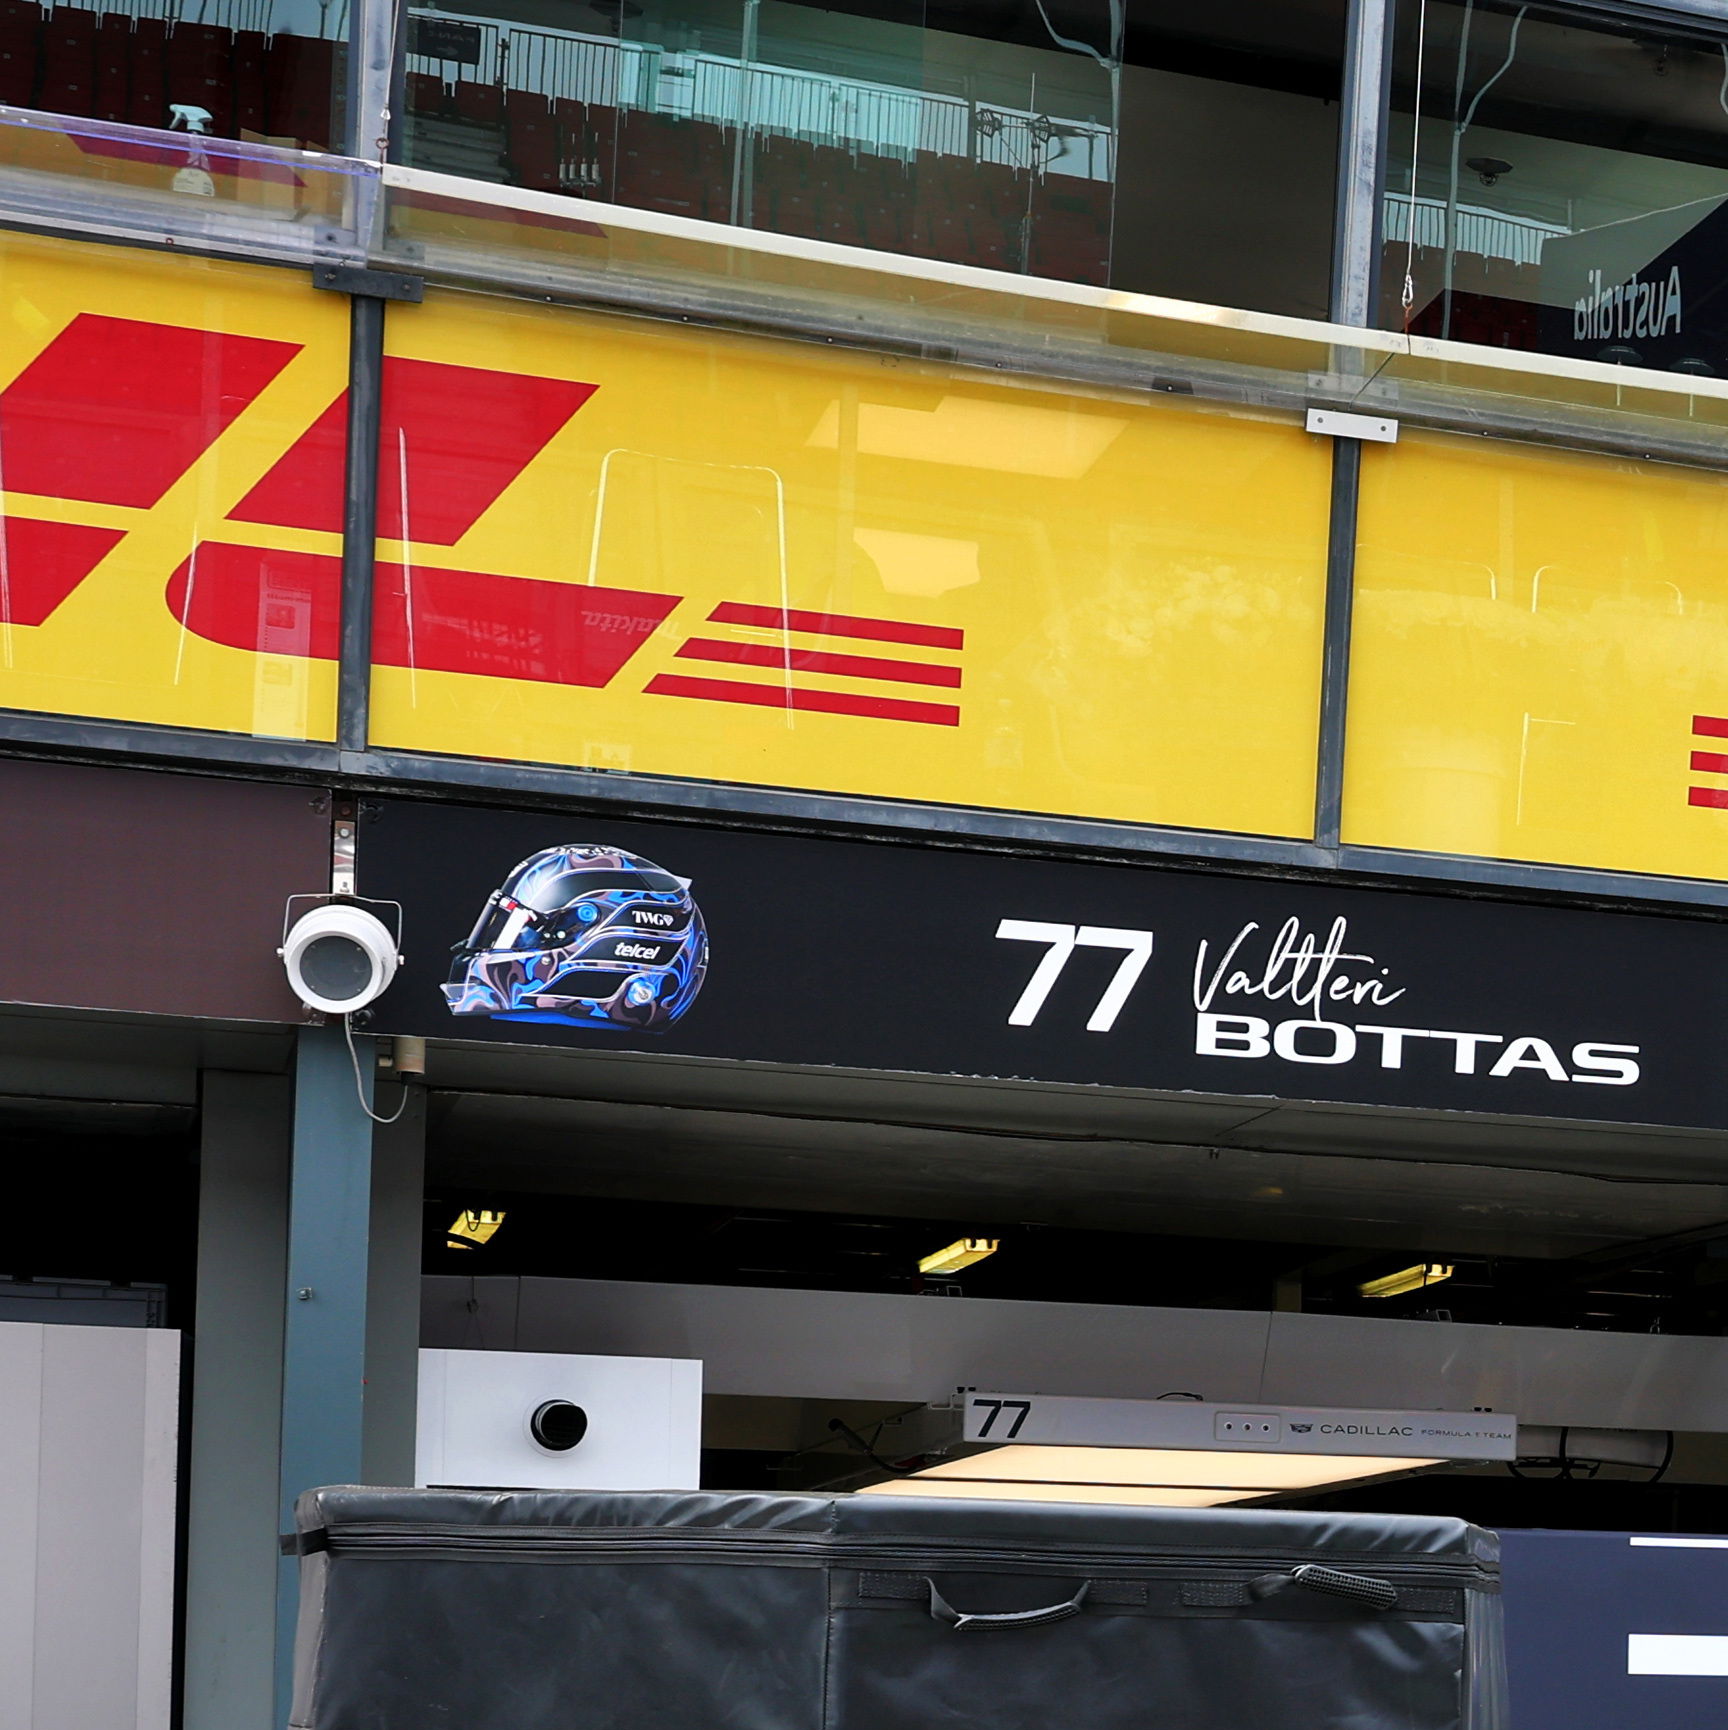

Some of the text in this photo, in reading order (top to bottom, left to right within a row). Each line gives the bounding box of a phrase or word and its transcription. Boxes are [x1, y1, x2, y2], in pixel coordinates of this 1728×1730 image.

[614, 942, 660, 960] telcel
[995, 915, 1406, 1032] 77 Valtteri
[1195, 1012, 1641, 1086] BOTTAS
[971, 1399, 1032, 1440] 77
[1320, 1422, 1414, 1438] CADILLAC
